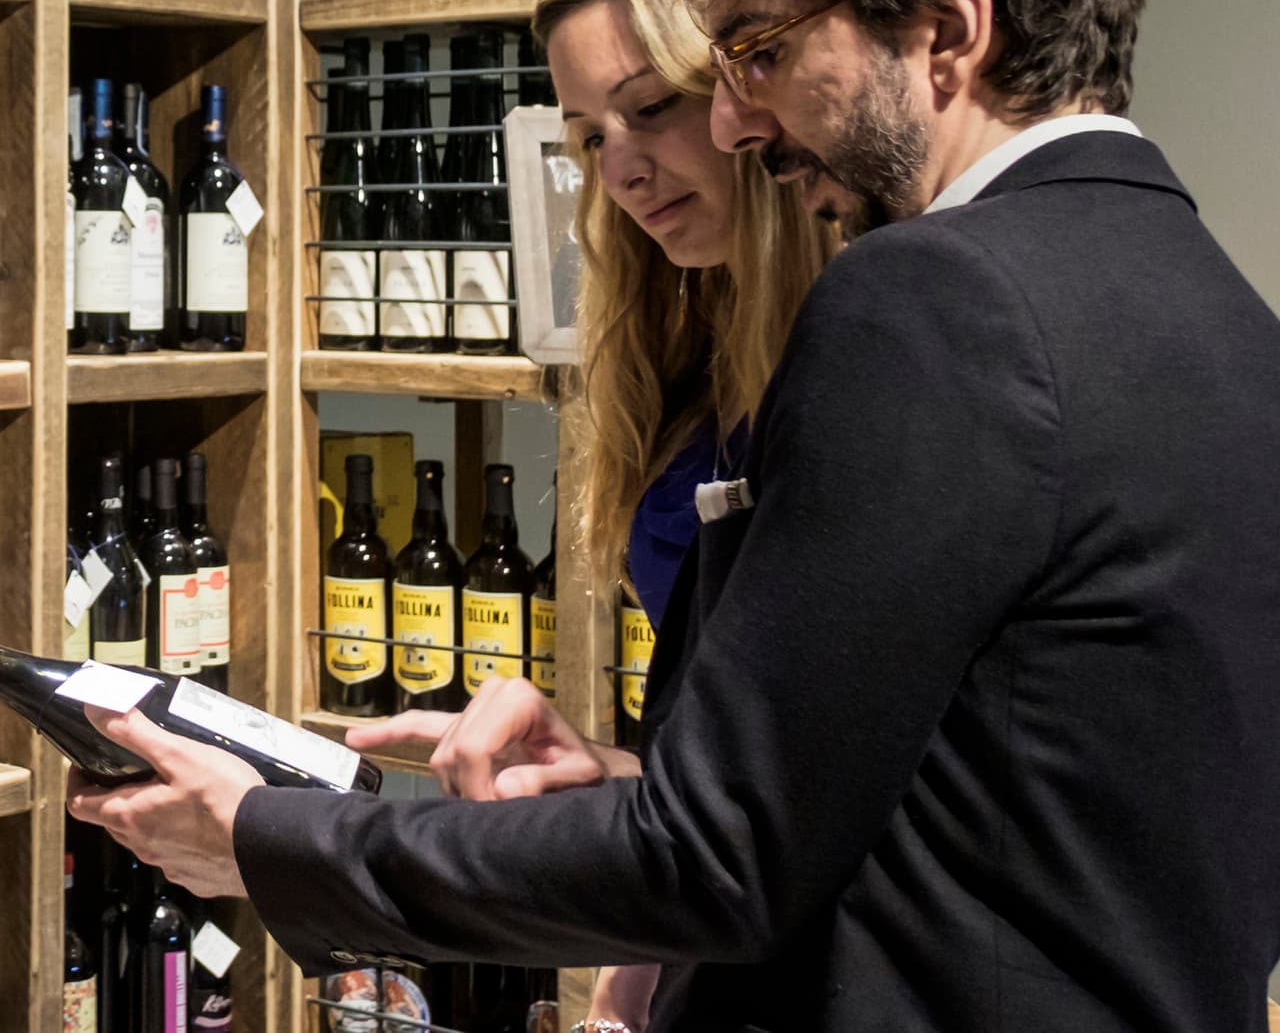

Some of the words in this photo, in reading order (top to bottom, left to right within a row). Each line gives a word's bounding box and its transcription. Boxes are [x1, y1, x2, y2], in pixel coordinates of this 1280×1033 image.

[327, 593, 375, 610] FOLLINA
[394, 599, 442, 617] FOLLINA
[625, 624, 654, 643] FOLL
